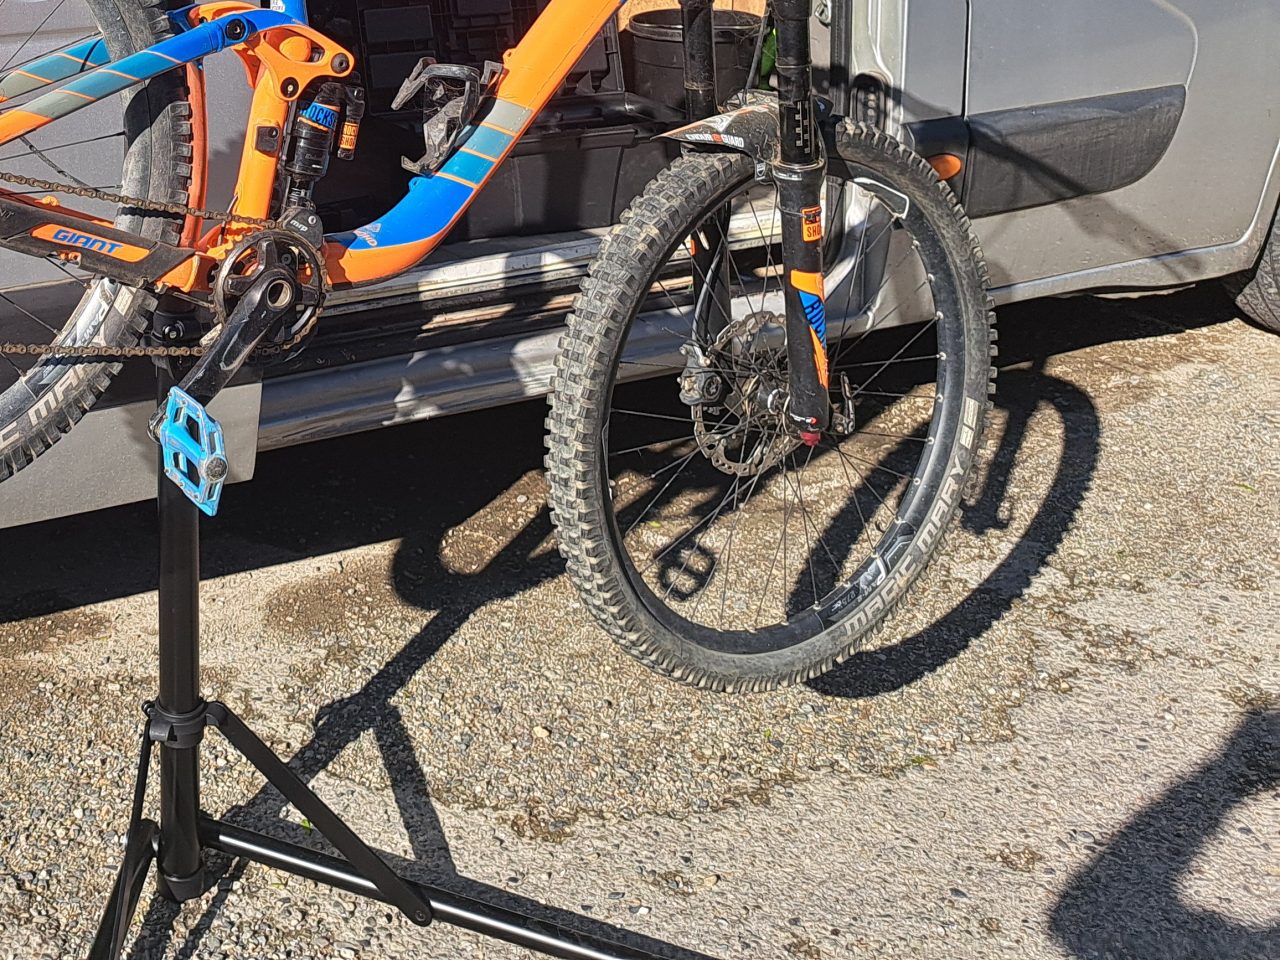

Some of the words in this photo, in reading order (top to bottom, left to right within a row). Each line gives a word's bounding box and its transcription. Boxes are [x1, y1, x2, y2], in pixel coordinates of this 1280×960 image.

[52, 228, 124, 255] GIANT
[843, 554, 917, 636] MAGIC
[916, 455, 965, 554] MARY
